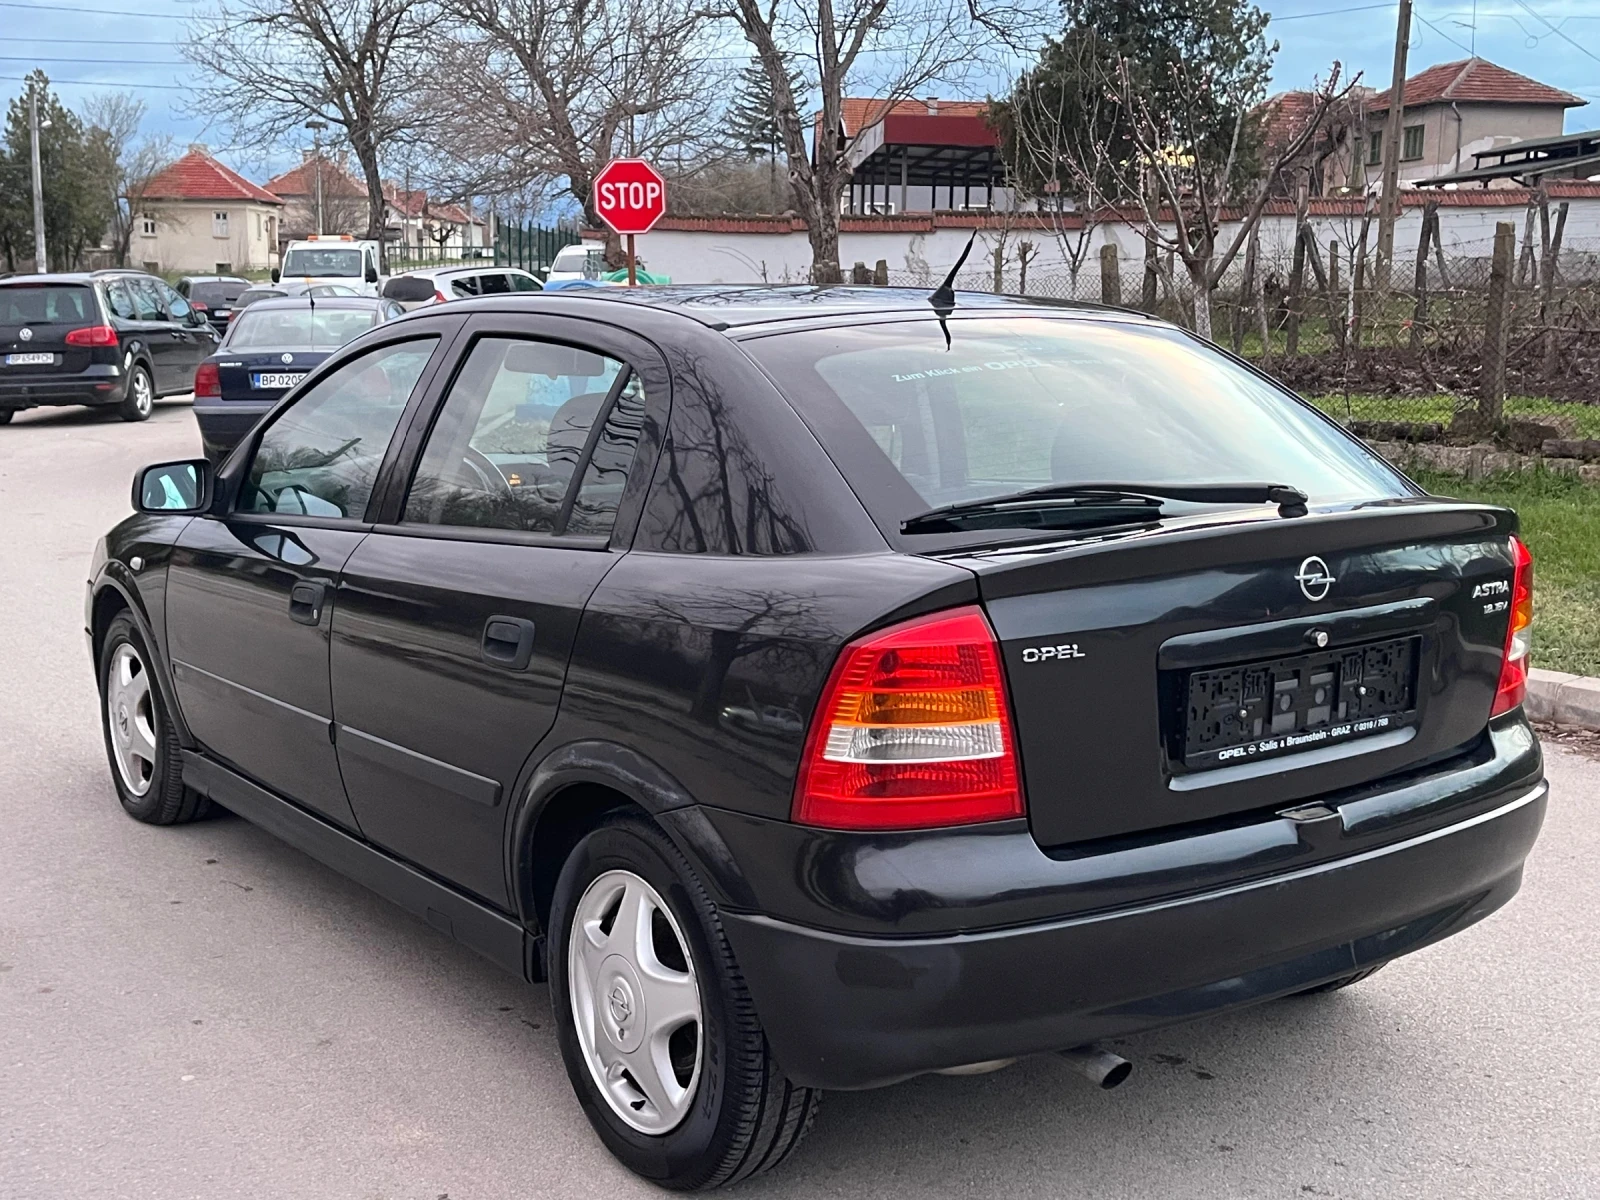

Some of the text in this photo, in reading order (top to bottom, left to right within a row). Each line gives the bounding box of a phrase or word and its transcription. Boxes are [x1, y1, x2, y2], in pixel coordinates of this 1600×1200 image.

[601, 181, 660, 210] STOP
[262, 375, 276, 386] BP
[891, 372, 926, 382] Zum
[924, 367, 961, 377] Klick
[962, 365, 983, 373] ein
[1472, 580, 1509, 599] ASTRA
[1022, 643, 1086, 662] OPEL
[1219, 747, 1247, 760] OPEL
[1259, 740, 1278, 752] Salis
[1286, 730, 1327, 746] Braunstein
[1331, 725, 1351, 737] GRAZ
